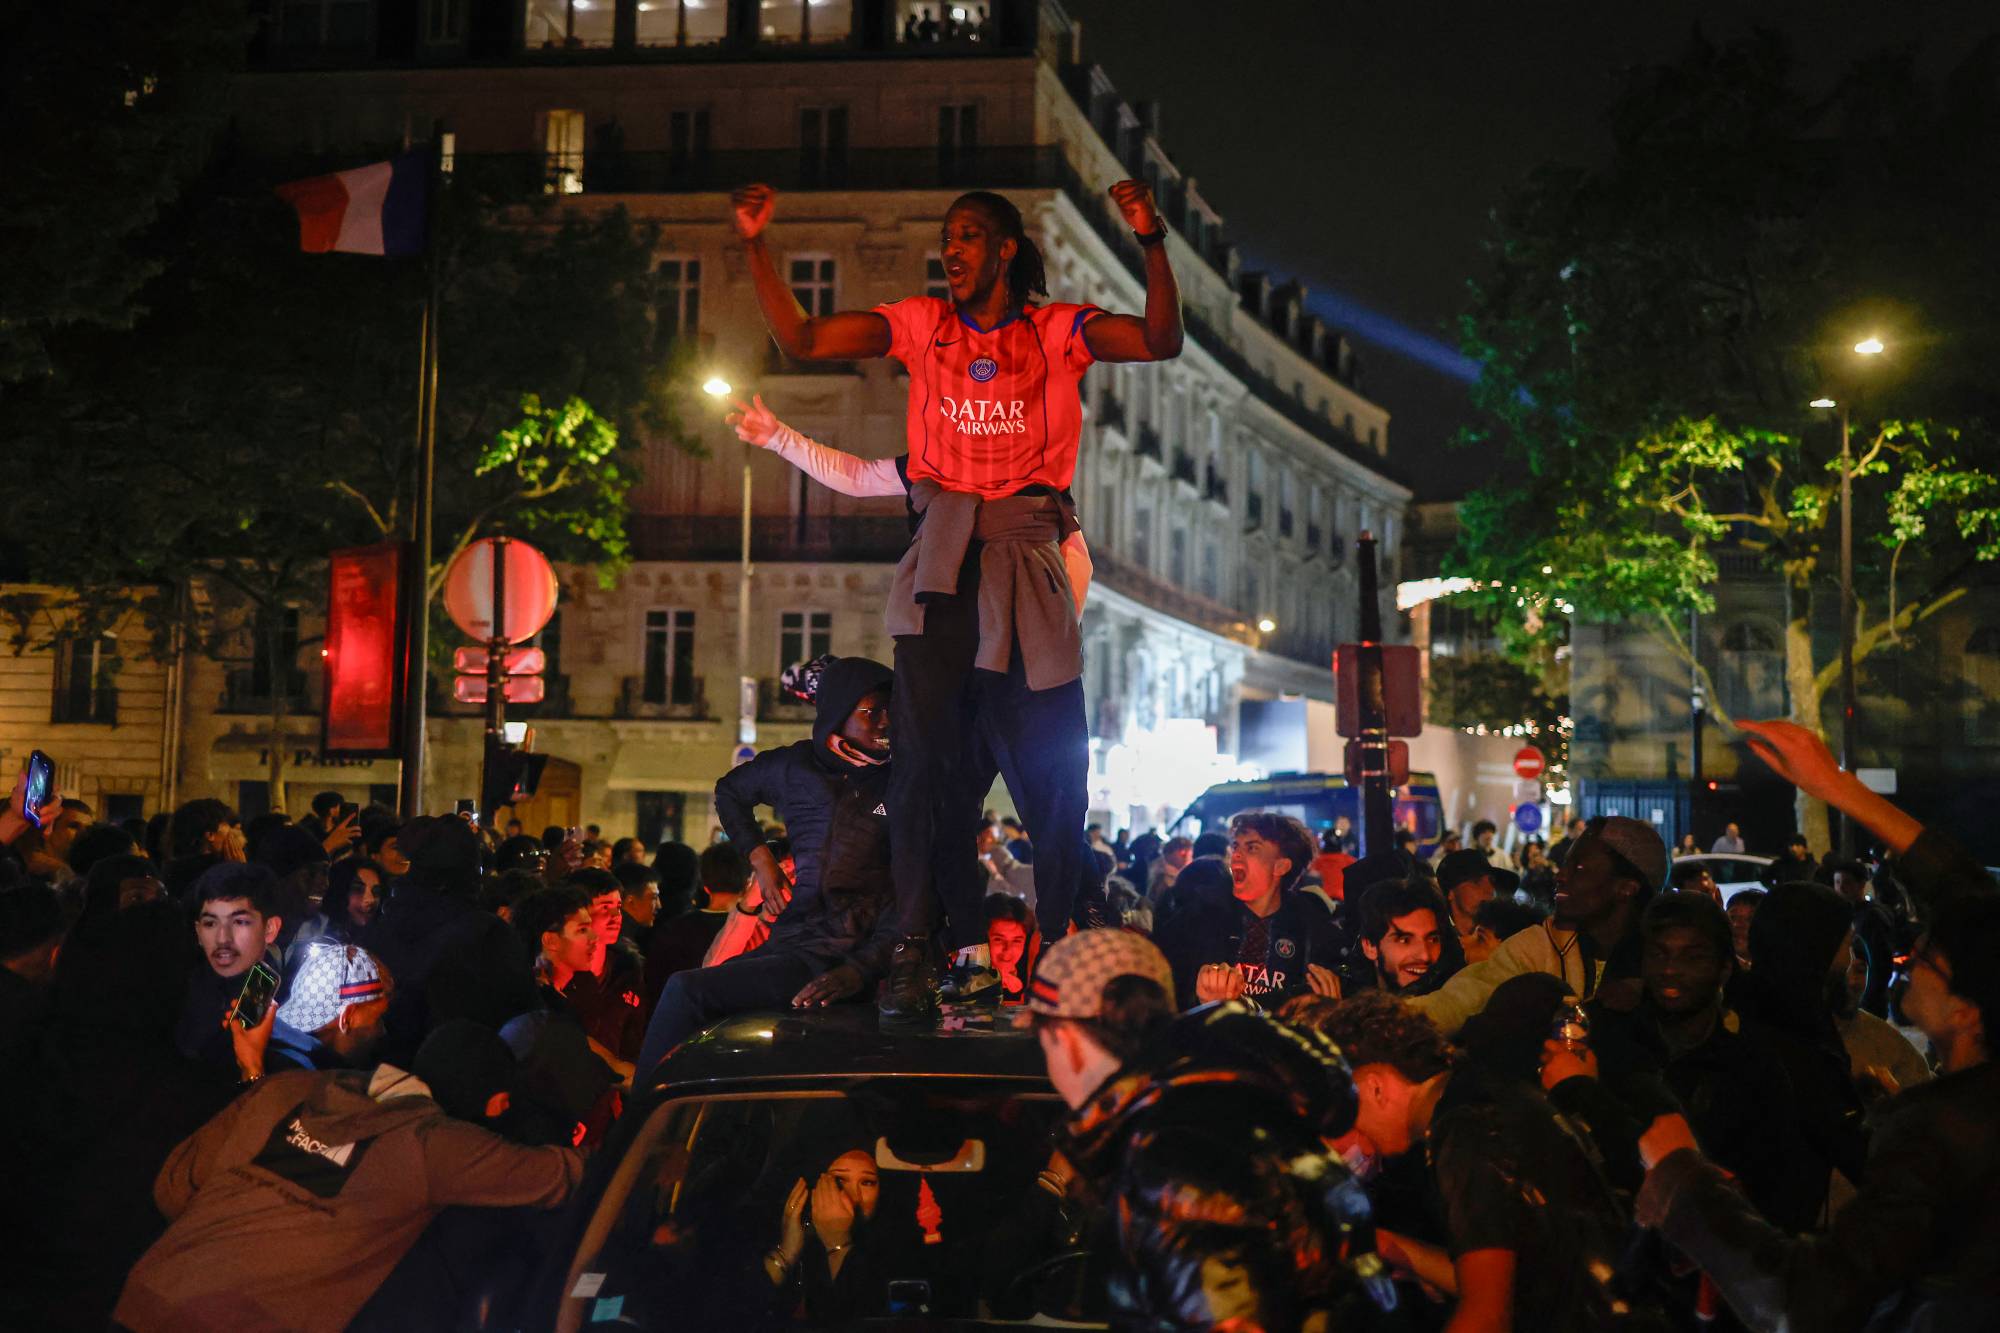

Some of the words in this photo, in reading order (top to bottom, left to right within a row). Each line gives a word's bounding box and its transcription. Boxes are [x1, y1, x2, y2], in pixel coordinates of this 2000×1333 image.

[940, 397, 1025, 422] QATAR
[956, 420, 1026, 435] AIRWAYS
[1235, 963, 1286, 990] ATAR
